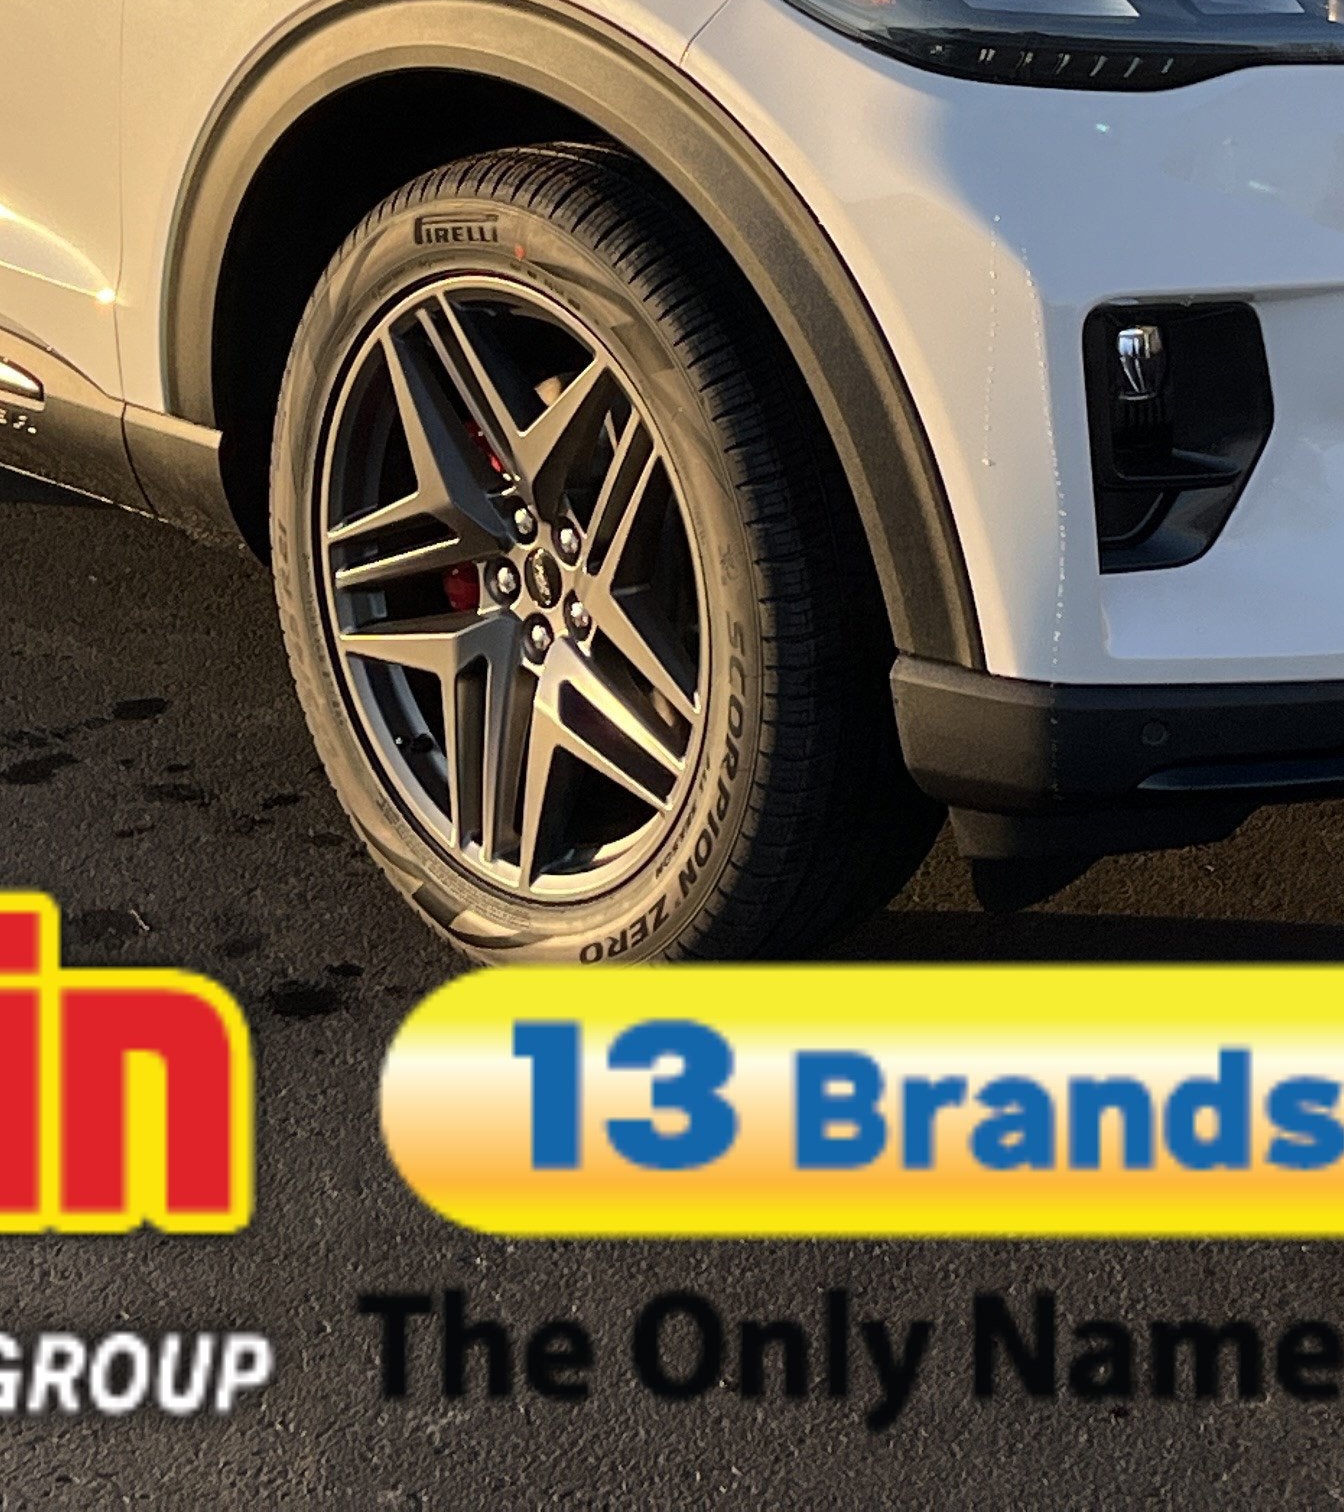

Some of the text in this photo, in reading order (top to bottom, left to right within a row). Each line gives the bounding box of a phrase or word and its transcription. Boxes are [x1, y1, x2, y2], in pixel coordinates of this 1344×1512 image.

[414, 213, 499, 245] PIRELLI
[678, 611, 746, 898] SCORPION
[578, 892, 671, 965] ZERO
